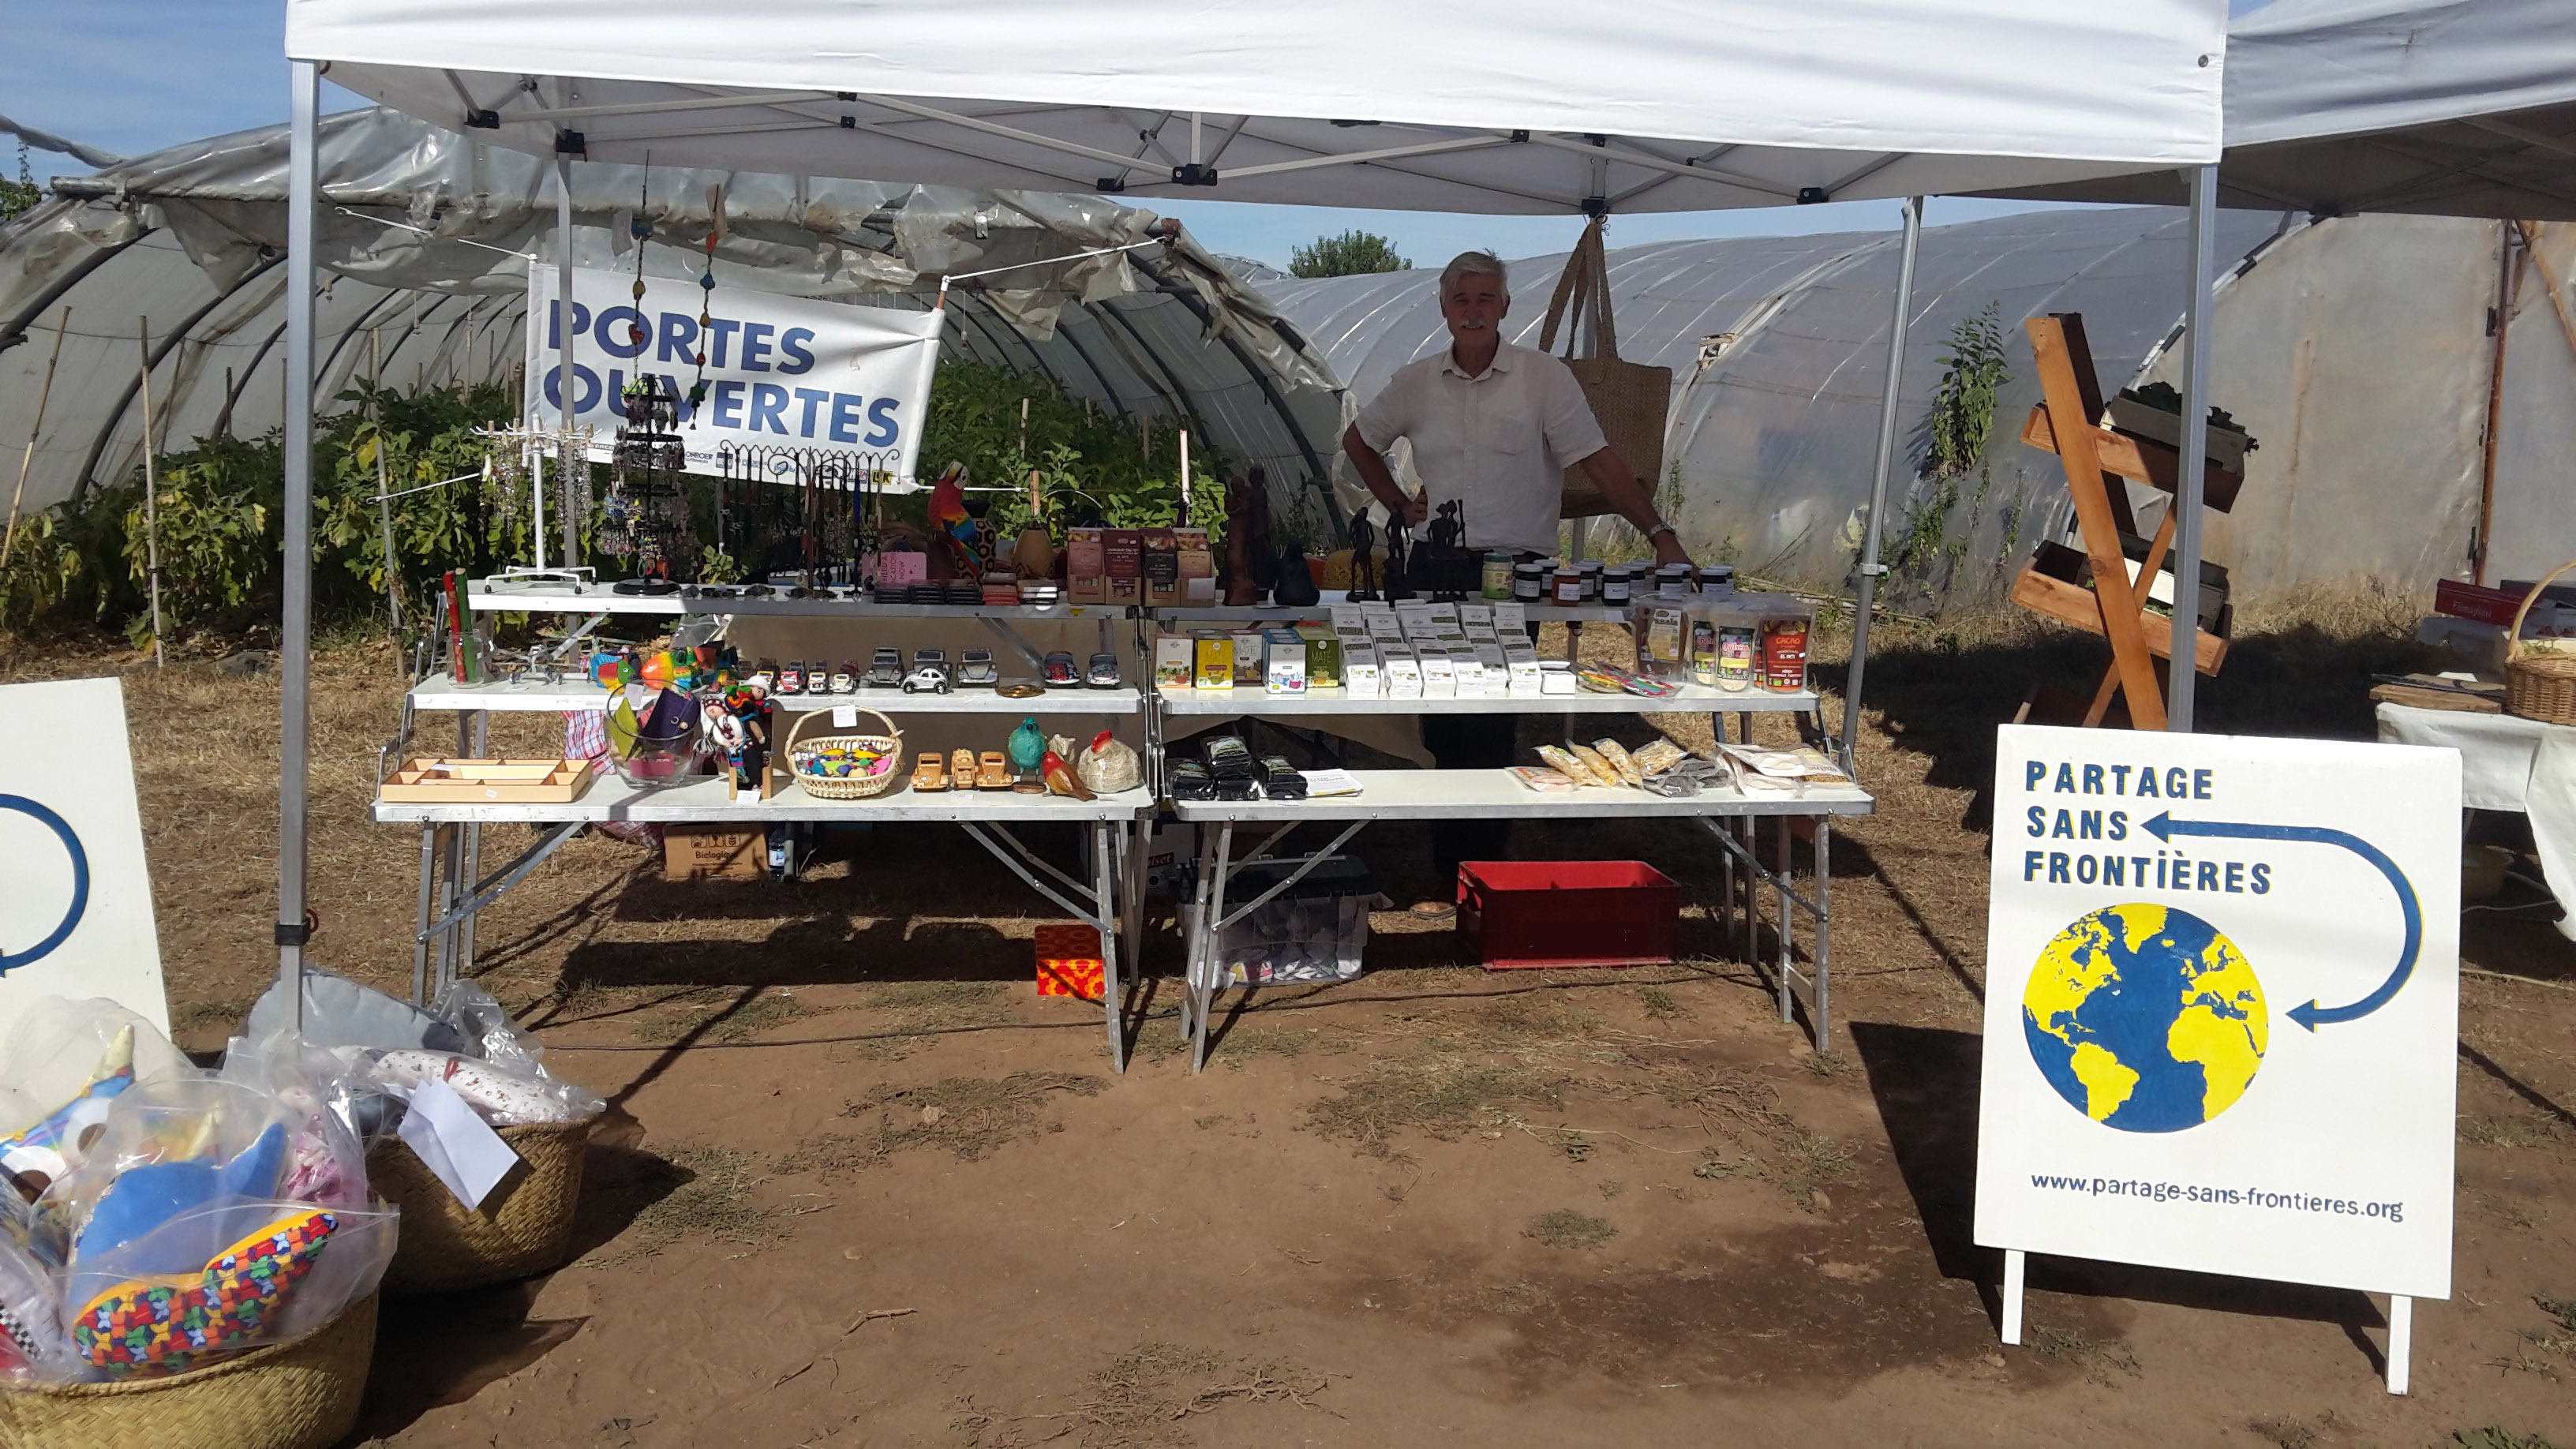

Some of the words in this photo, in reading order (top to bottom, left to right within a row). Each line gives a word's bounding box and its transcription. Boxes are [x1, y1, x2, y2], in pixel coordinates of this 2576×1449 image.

[549, 299, 814, 375] PORTES
[543, 363, 900, 447] OUVERTES
[2025, 760, 2214, 799] PARTAGE
[2026, 805, 2130, 841] SANS
[2024, 849, 2272, 895] FRONTIÈRES
[2031, 1174, 2404, 1223] www.partage-sans-frontieres.org
